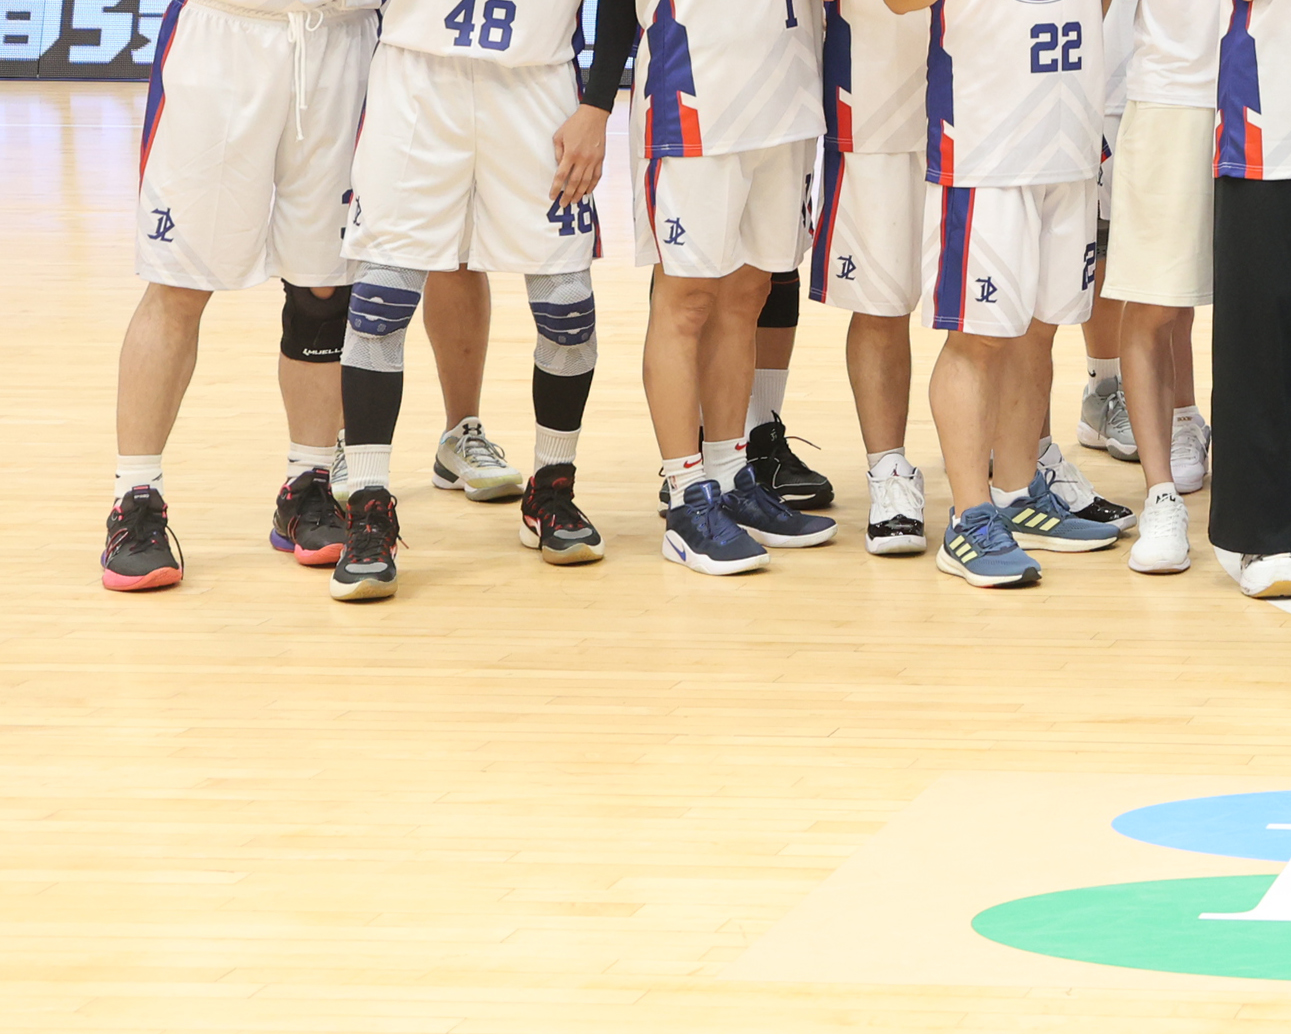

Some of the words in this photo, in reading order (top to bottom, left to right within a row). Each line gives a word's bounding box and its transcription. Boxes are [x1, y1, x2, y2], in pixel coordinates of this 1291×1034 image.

[1029, 21, 1083, 74] 22
[546, 190, 592, 236] 48
[308, 347, 342, 356] MUELL
